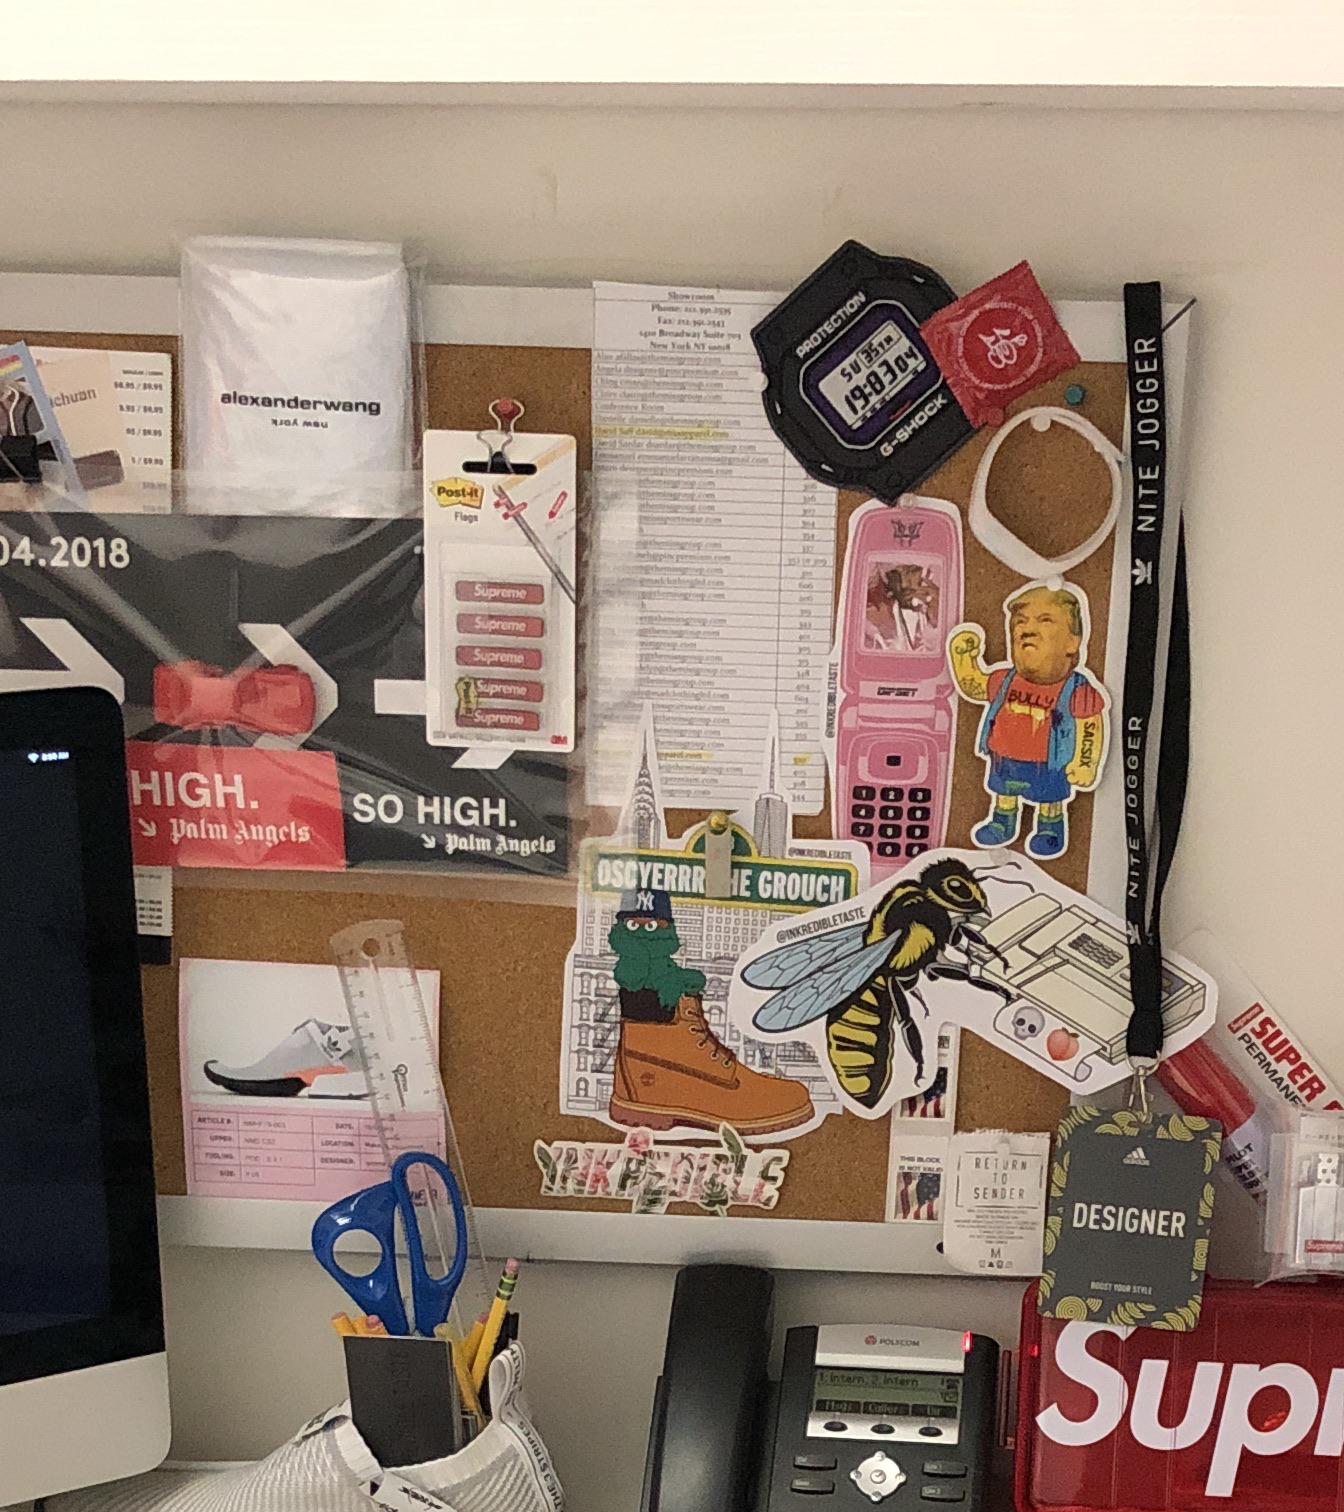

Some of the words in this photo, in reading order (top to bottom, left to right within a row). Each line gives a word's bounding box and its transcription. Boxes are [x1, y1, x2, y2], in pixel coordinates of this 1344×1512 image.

[796, 291, 866, 359] PROTECTION
[221, 391, 381, 416] alexanderwang
[1136, 336, 1159, 452] JOGGER
[880, 394, 948, 457] G-SHOCK
[437, 486, 480, 499] Post-it
[1138, 470, 1159, 533] NITE
[454, 512, 479, 523] Flags
[474, 584, 527, 600] Supreme
[475, 617, 526, 633] Supreme
[473, 649, 525, 664] Supreme
[476, 680, 527, 697] Supreme
[1008, 689, 1053, 707] BULLY
[473, 711, 524, 726] Supreme
[1078, 722, 1096, 768] SACSIX
[1126, 716, 1144, 825] JOGGER
[130, 770, 259, 812] HIGH.
[353, 796, 404, 826] SO
[417, 796, 518, 828] HIGH.
[170, 817, 229, 844] Palm
[235, 819, 310, 845] Angels
[445, 833, 491, 854] Palm
[495, 834, 555, 856] Angels
[1128, 835, 1142, 900] NITE
[759, 870, 845, 902] GROUCH
[776, 906, 867, 944] @INKREDIBLETASTE
[1250, 1016, 1327, 1104] SUPER
[975, 1157, 1027, 1171] RETURN
[993, 1173, 1008, 1184] TO
[974, 1187, 1025, 1199] SENDER
[1073, 1202, 1186, 1238] DESIGNER
[991, 1248, 1001, 1258] M
[1133, 1285, 1152, 1295] STYLE
[879, 1339, 920, 1347] POLYCOM
